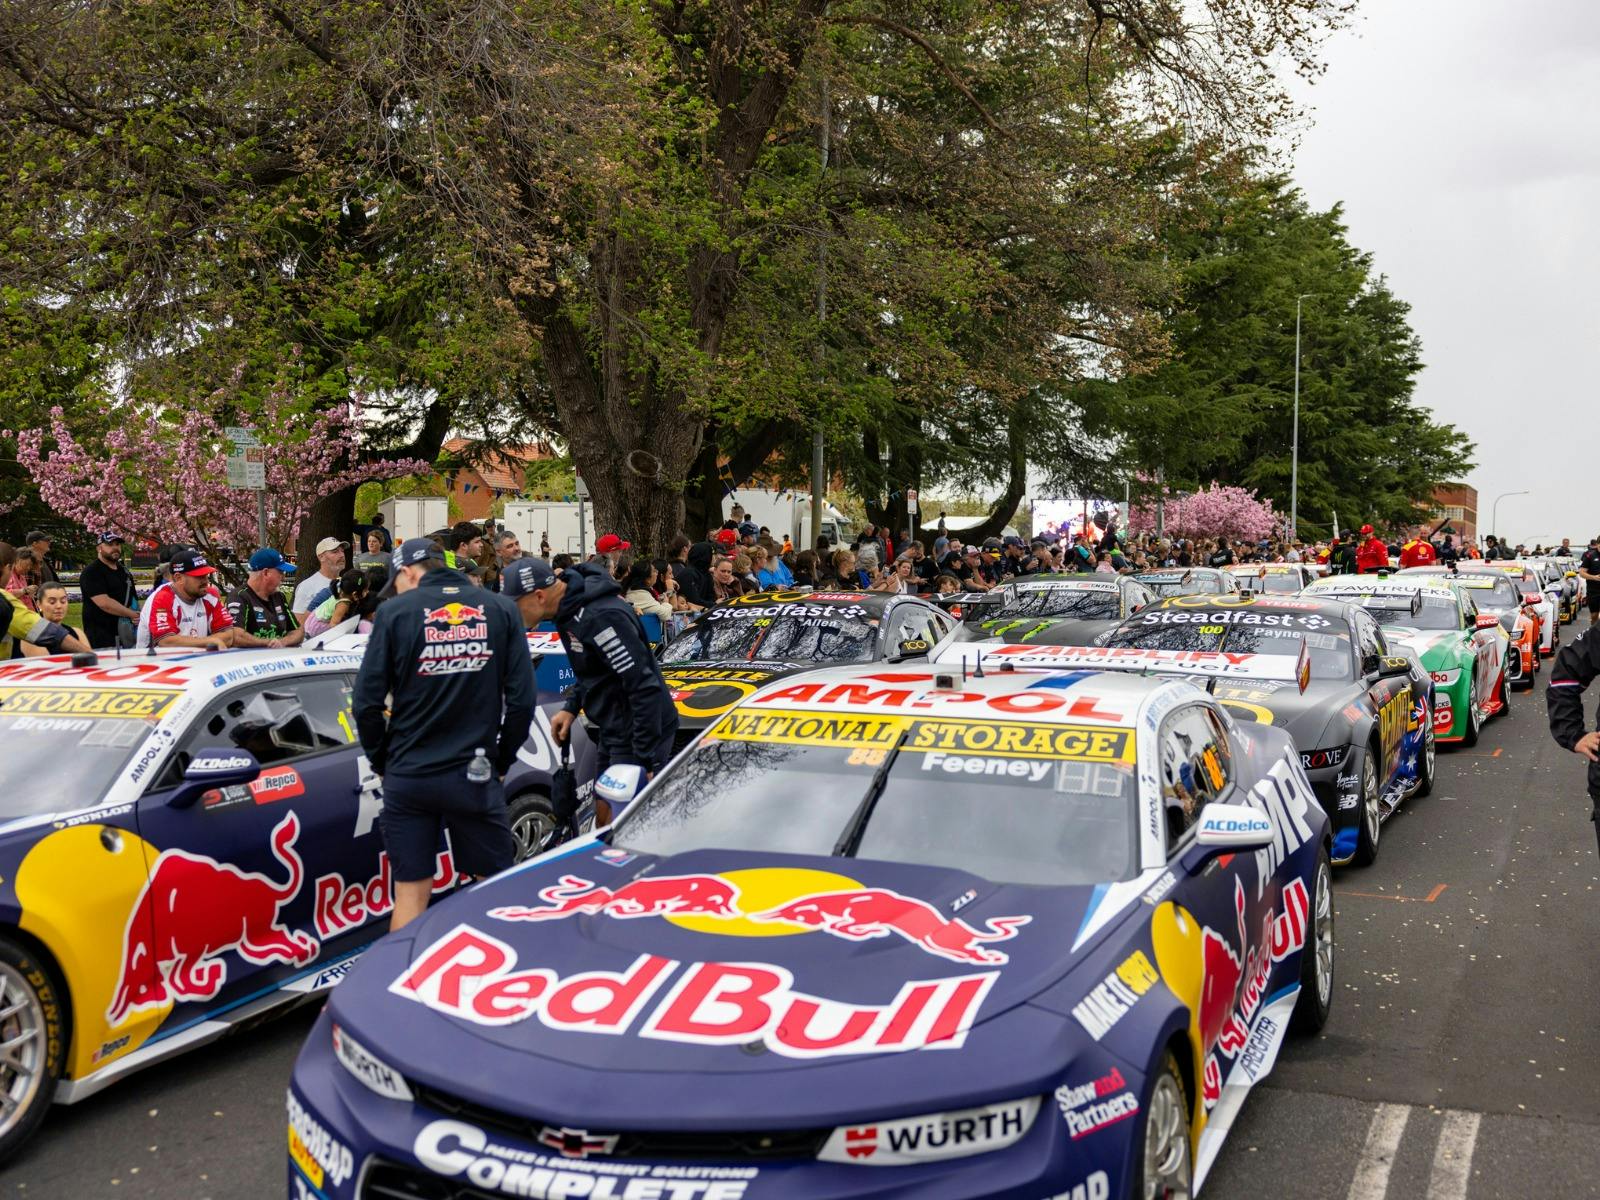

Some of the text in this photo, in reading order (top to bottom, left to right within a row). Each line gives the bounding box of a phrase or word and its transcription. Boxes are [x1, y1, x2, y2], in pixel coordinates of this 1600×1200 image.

[1377, 585, 1451, 597] TRUCKS
[707, 602, 837, 621] Steadfast
[1142, 610, 1294, 627] Steadfast
[753, 618, 773, 627] 26
[803, 618, 838, 628] Allen
[1198, 625, 1225, 635] 100
[424, 623, 488, 643] Red Bull
[1254, 627, 1300, 639] Payne
[420, 641, 494, 660] AMPOL
[904, 641, 927, 651] 100
[1026, 646, 1257, 665] AMPLIFY
[315, 654, 347, 665] SCOTT
[417, 656, 491, 674] RACING
[981, 654, 1250, 674] Premium Fuels
[1382, 657, 1408, 669] 100
[225, 659, 295, 683] WILL BROWN
[3, 692, 169, 714] STORAGE
[754, 683, 1125, 722] AMPOL
[9, 716, 95, 731] Brown
[718, 713, 1116, 758] NATIONAL STORAGE
[130, 745, 162, 784] AMPOL
[188, 756, 252, 770] ACDelco
[921, 751, 1053, 782] Feeney
[265, 773, 297, 791] Repco
[67, 804, 133, 828] DUNLOP
[1204, 820, 1270, 832] ACDelco
[313, 851, 395, 941] Red
[388, 923, 1000, 1058] Red Bull
[1054, 1083, 1097, 1112] Shaw
[1063, 1091, 1139, 1137] Partners
[887, 1108, 1023, 1152] WÜRTH
[483, 1144, 532, 1165] PARTS
[547, 1157, 650, 1177] EQUIPMENT
[649, 1165, 759, 1180] SOLUTIONS
